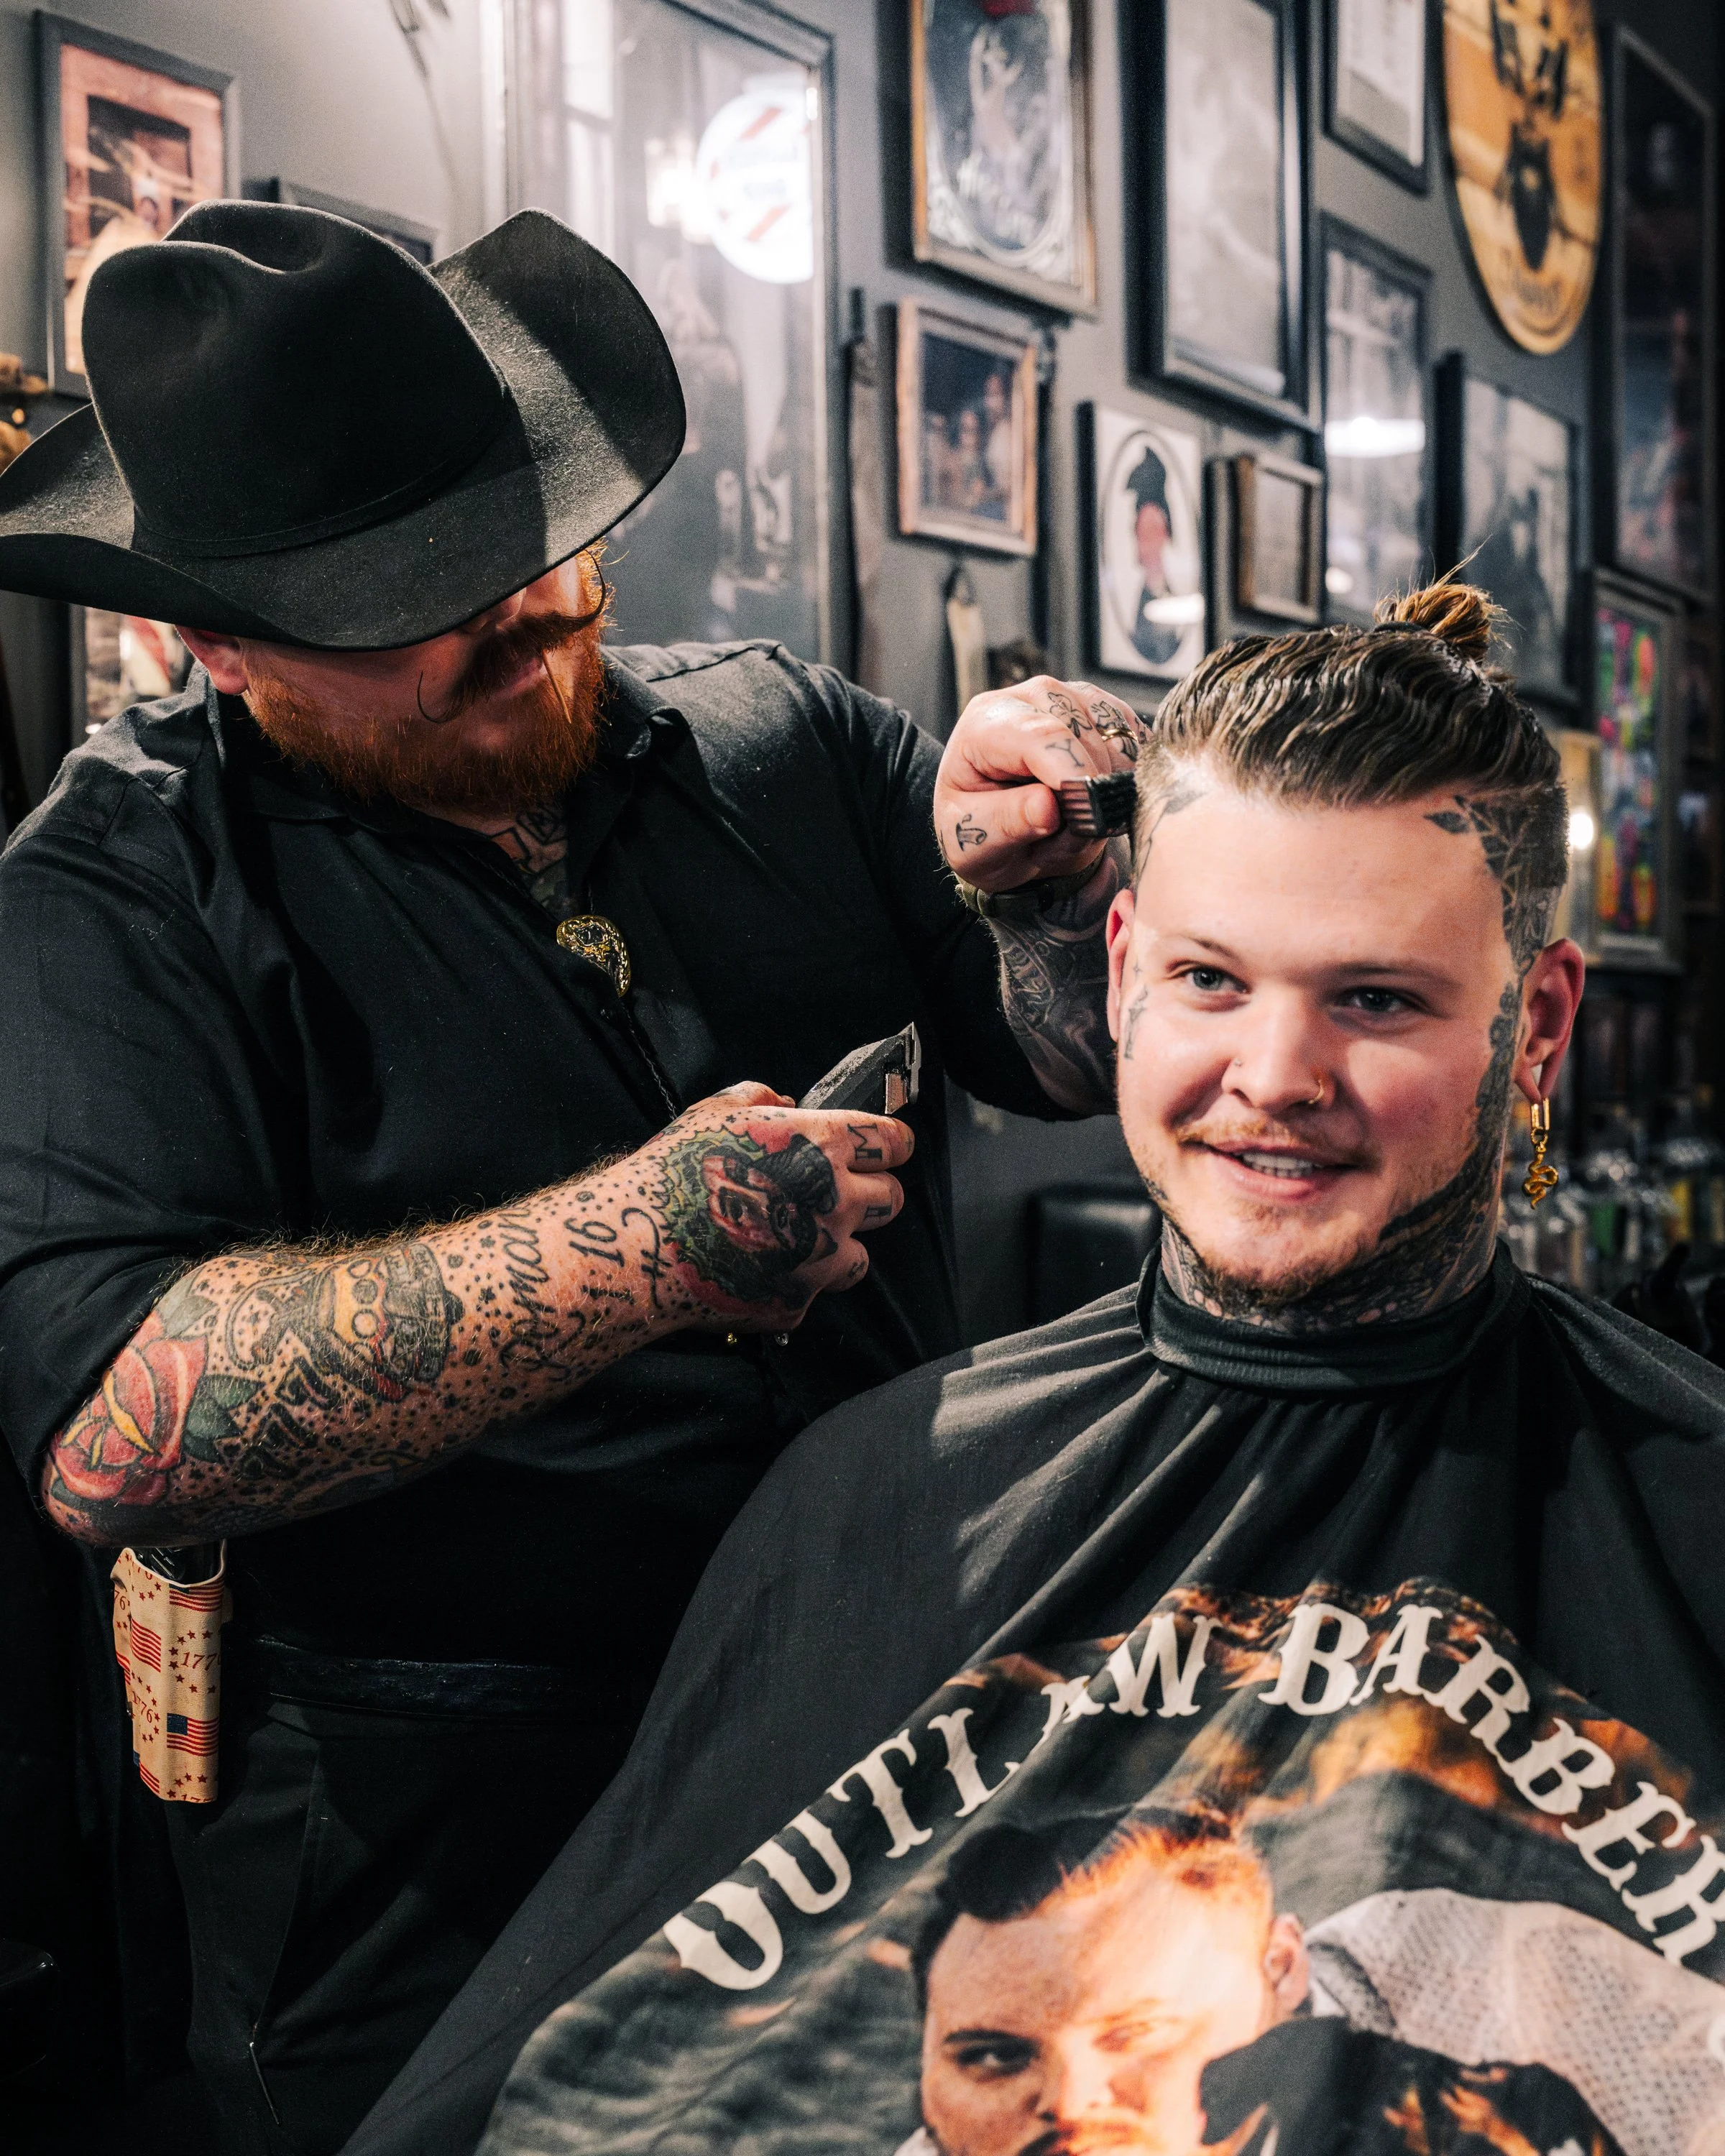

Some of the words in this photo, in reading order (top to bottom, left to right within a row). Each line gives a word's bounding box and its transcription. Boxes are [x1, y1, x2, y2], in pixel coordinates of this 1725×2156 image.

[180, 1651, 221, 1672] 177
[132, 1690, 152, 1723] 1776
[663, 1612, 1222, 1991] OUTLAW
[1258, 1603, 1725, 1966] BARBER
